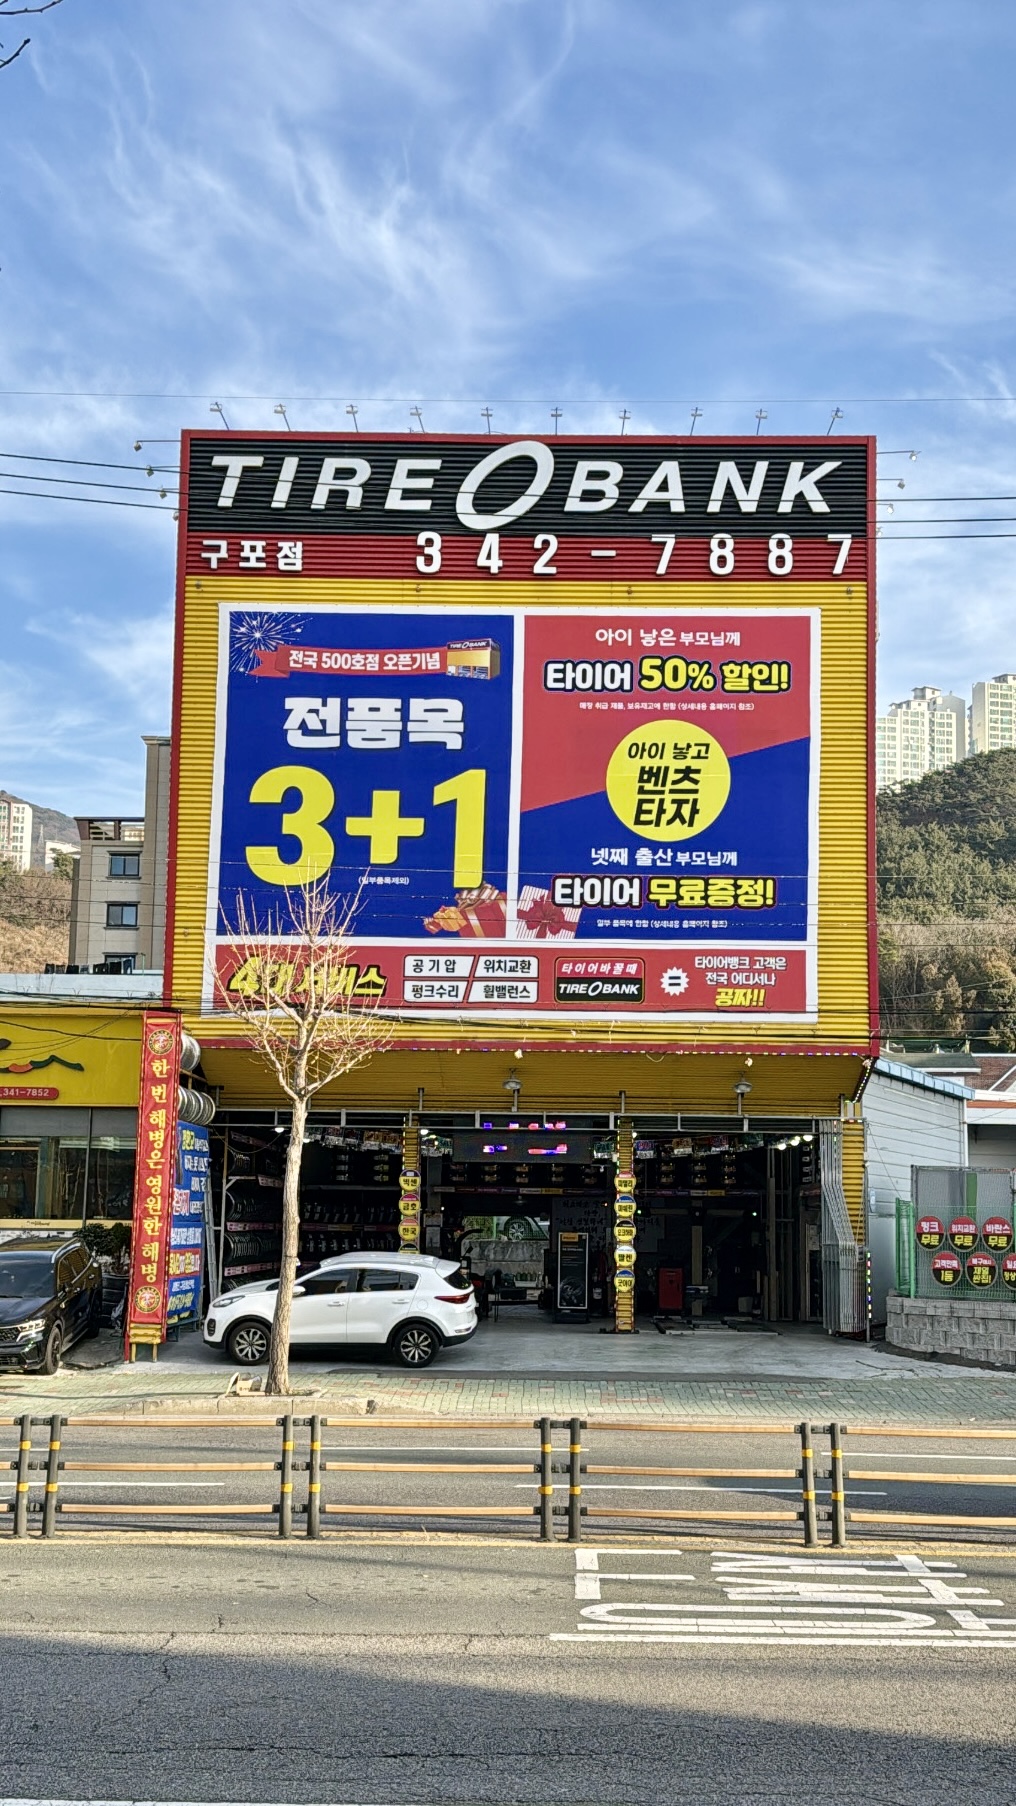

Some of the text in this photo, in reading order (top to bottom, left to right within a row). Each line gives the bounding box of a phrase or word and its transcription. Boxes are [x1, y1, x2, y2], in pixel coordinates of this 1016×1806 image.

[200, 531, 853, 576] 구포점 342-7887
[595, 628, 741, 647] 아이 낳은 부모님께
[289, 651, 441, 671] 전국 500호점 오픈기념
[546, 657, 790, 691] 타이어 50% 할인!
[595, 702, 608, 711] 취급
[627, 702, 661, 711] 보유재고에
[663, 702, 676, 711] 한함
[709, 702, 736, 711] 홈페이지
[283, 696, 465, 750] 전품목
[627, 742, 710, 760] 아이 낳고
[637, 765, 702, 796] 벤츠
[634, 798, 700, 827] 타자
[245, 765, 486, 889] 3+1
[591, 847, 738, 867] 넷째 출산 부모님께
[554, 877, 775, 907] 타이어 무료증정!
[597, 919, 611, 929] 일부
[613, 919, 633, 929] 품목에
[635, 919, 649, 929] 한함
[682, 919, 709, 929] 홈페이지
[483, 958, 531, 973] 위치교환
[695, 956, 787, 970] 타이어뱅크 고객은
[705, 971, 776, 986] 전국 어디서나
[411, 984, 531, 999] 펑크수리 휠밸런스
[715, 988, 766, 1007] 공짜!!
[141, 1059, 170, 1283] 한 번 해병은 영원한 해병
[402, 1202, 417, 1211] 금호
[402, 1227, 417, 1236] 한국
[921, 1221, 939, 1232] 펑크
[921, 1234, 939, 1245] 무료
[954, 1235, 973, 1246] 무료
[988, 1235, 1008, 1247] 무료
[941, 1270, 954, 1282] 1등
